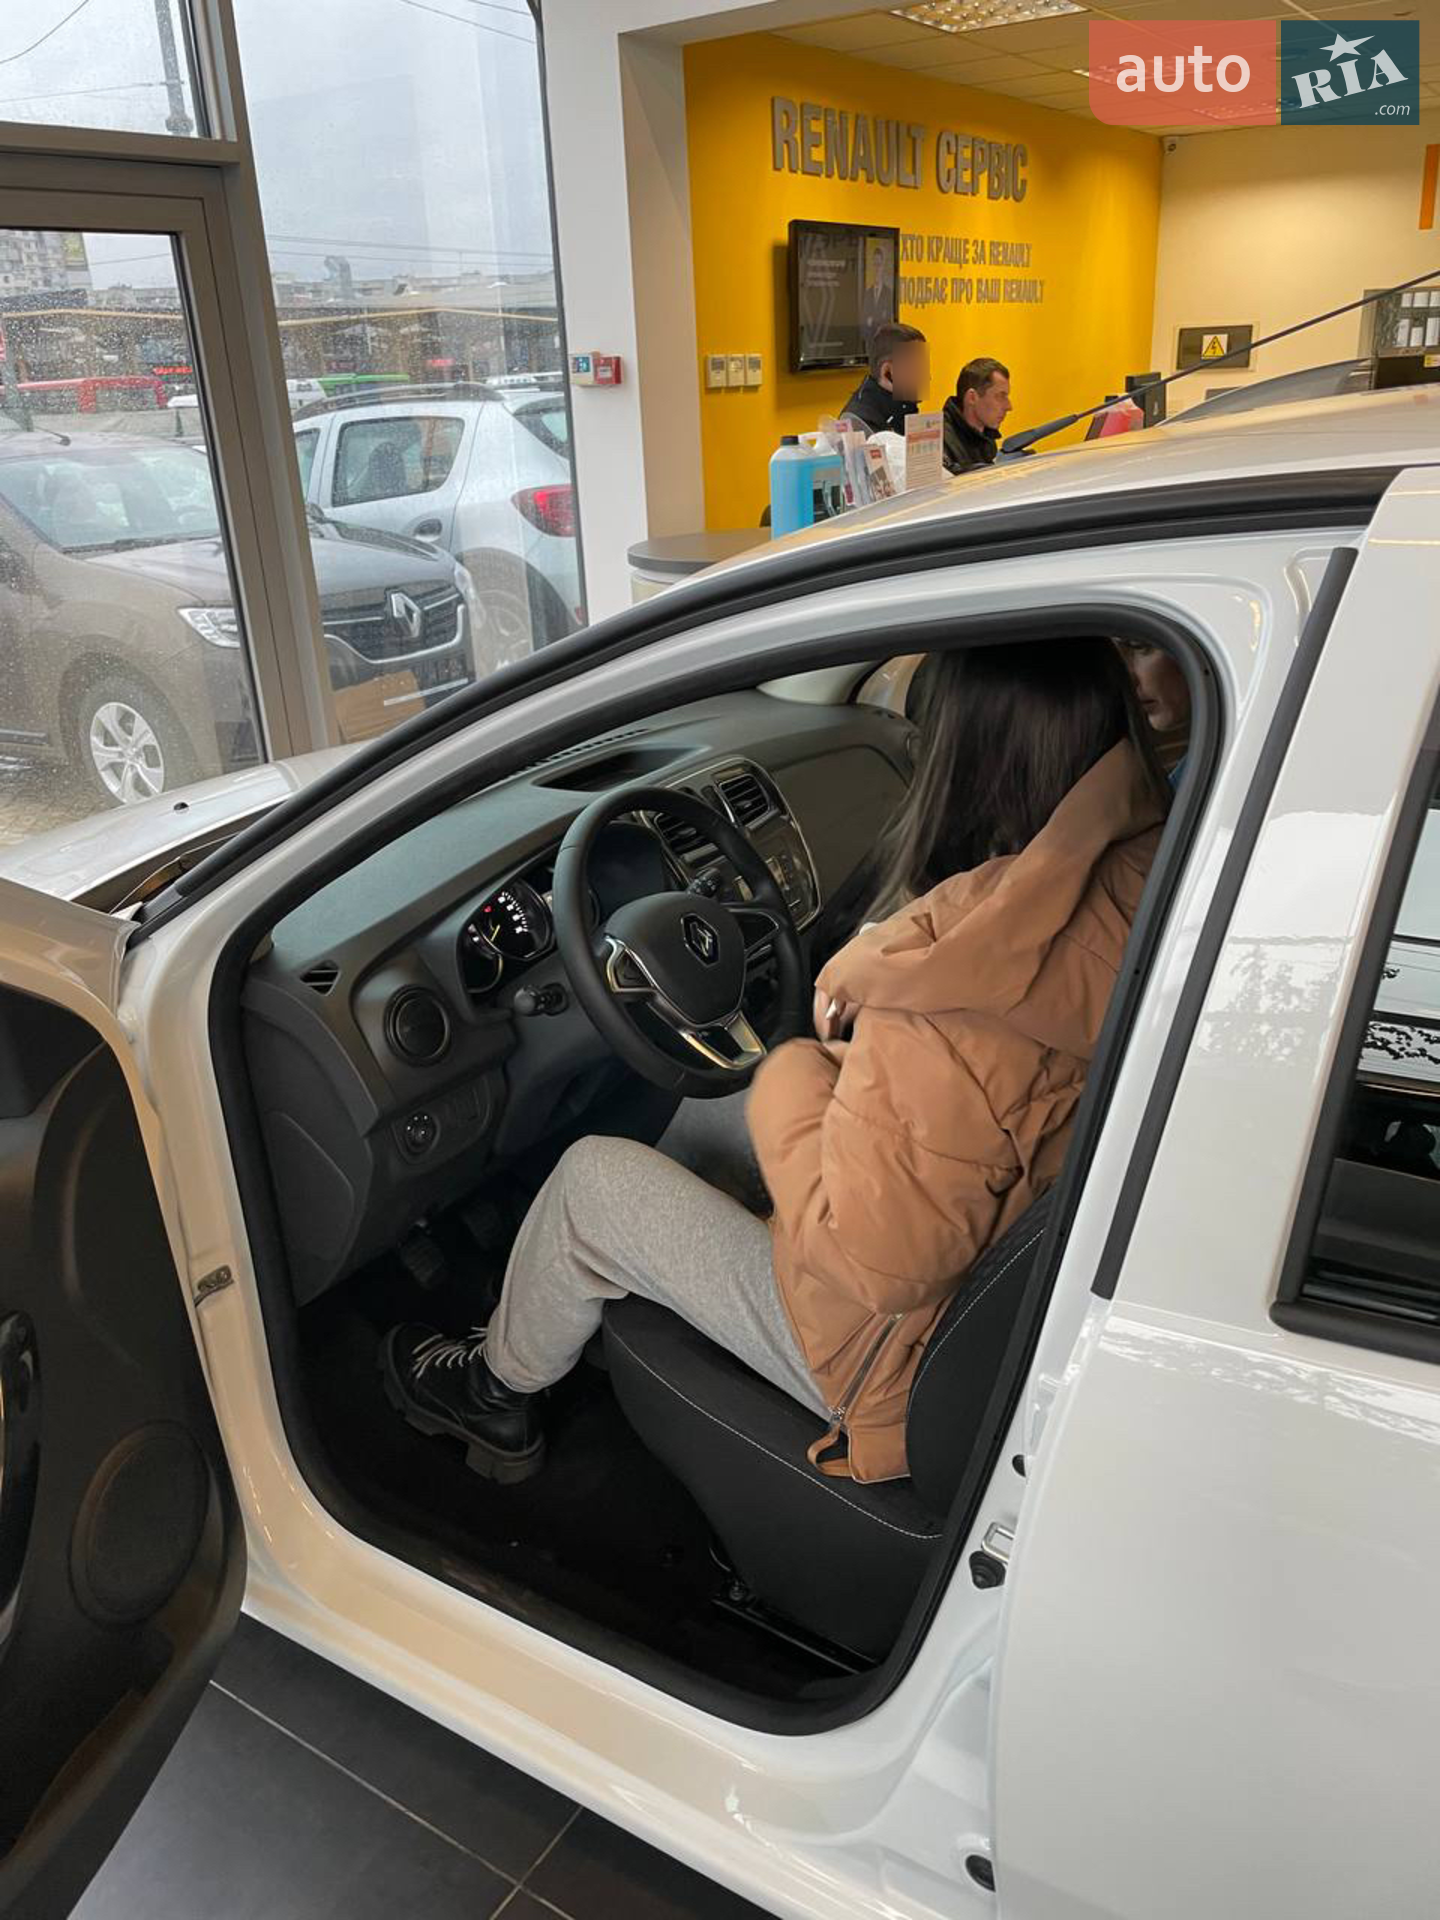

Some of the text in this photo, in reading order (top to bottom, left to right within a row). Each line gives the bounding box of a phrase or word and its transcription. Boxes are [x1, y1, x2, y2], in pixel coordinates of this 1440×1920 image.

[771, 96, 1028, 202] RENAULT СЕРВІС
[927, 236, 970, 269] КРАЩЕ
[971, 239, 986, 265] ЗА
[989, 240, 1032, 268] RENAULT
[951, 277, 973, 305] ПРО
[977, 278, 1000, 304] ВАШ
[1004, 279, 1045, 304] RENAULT
